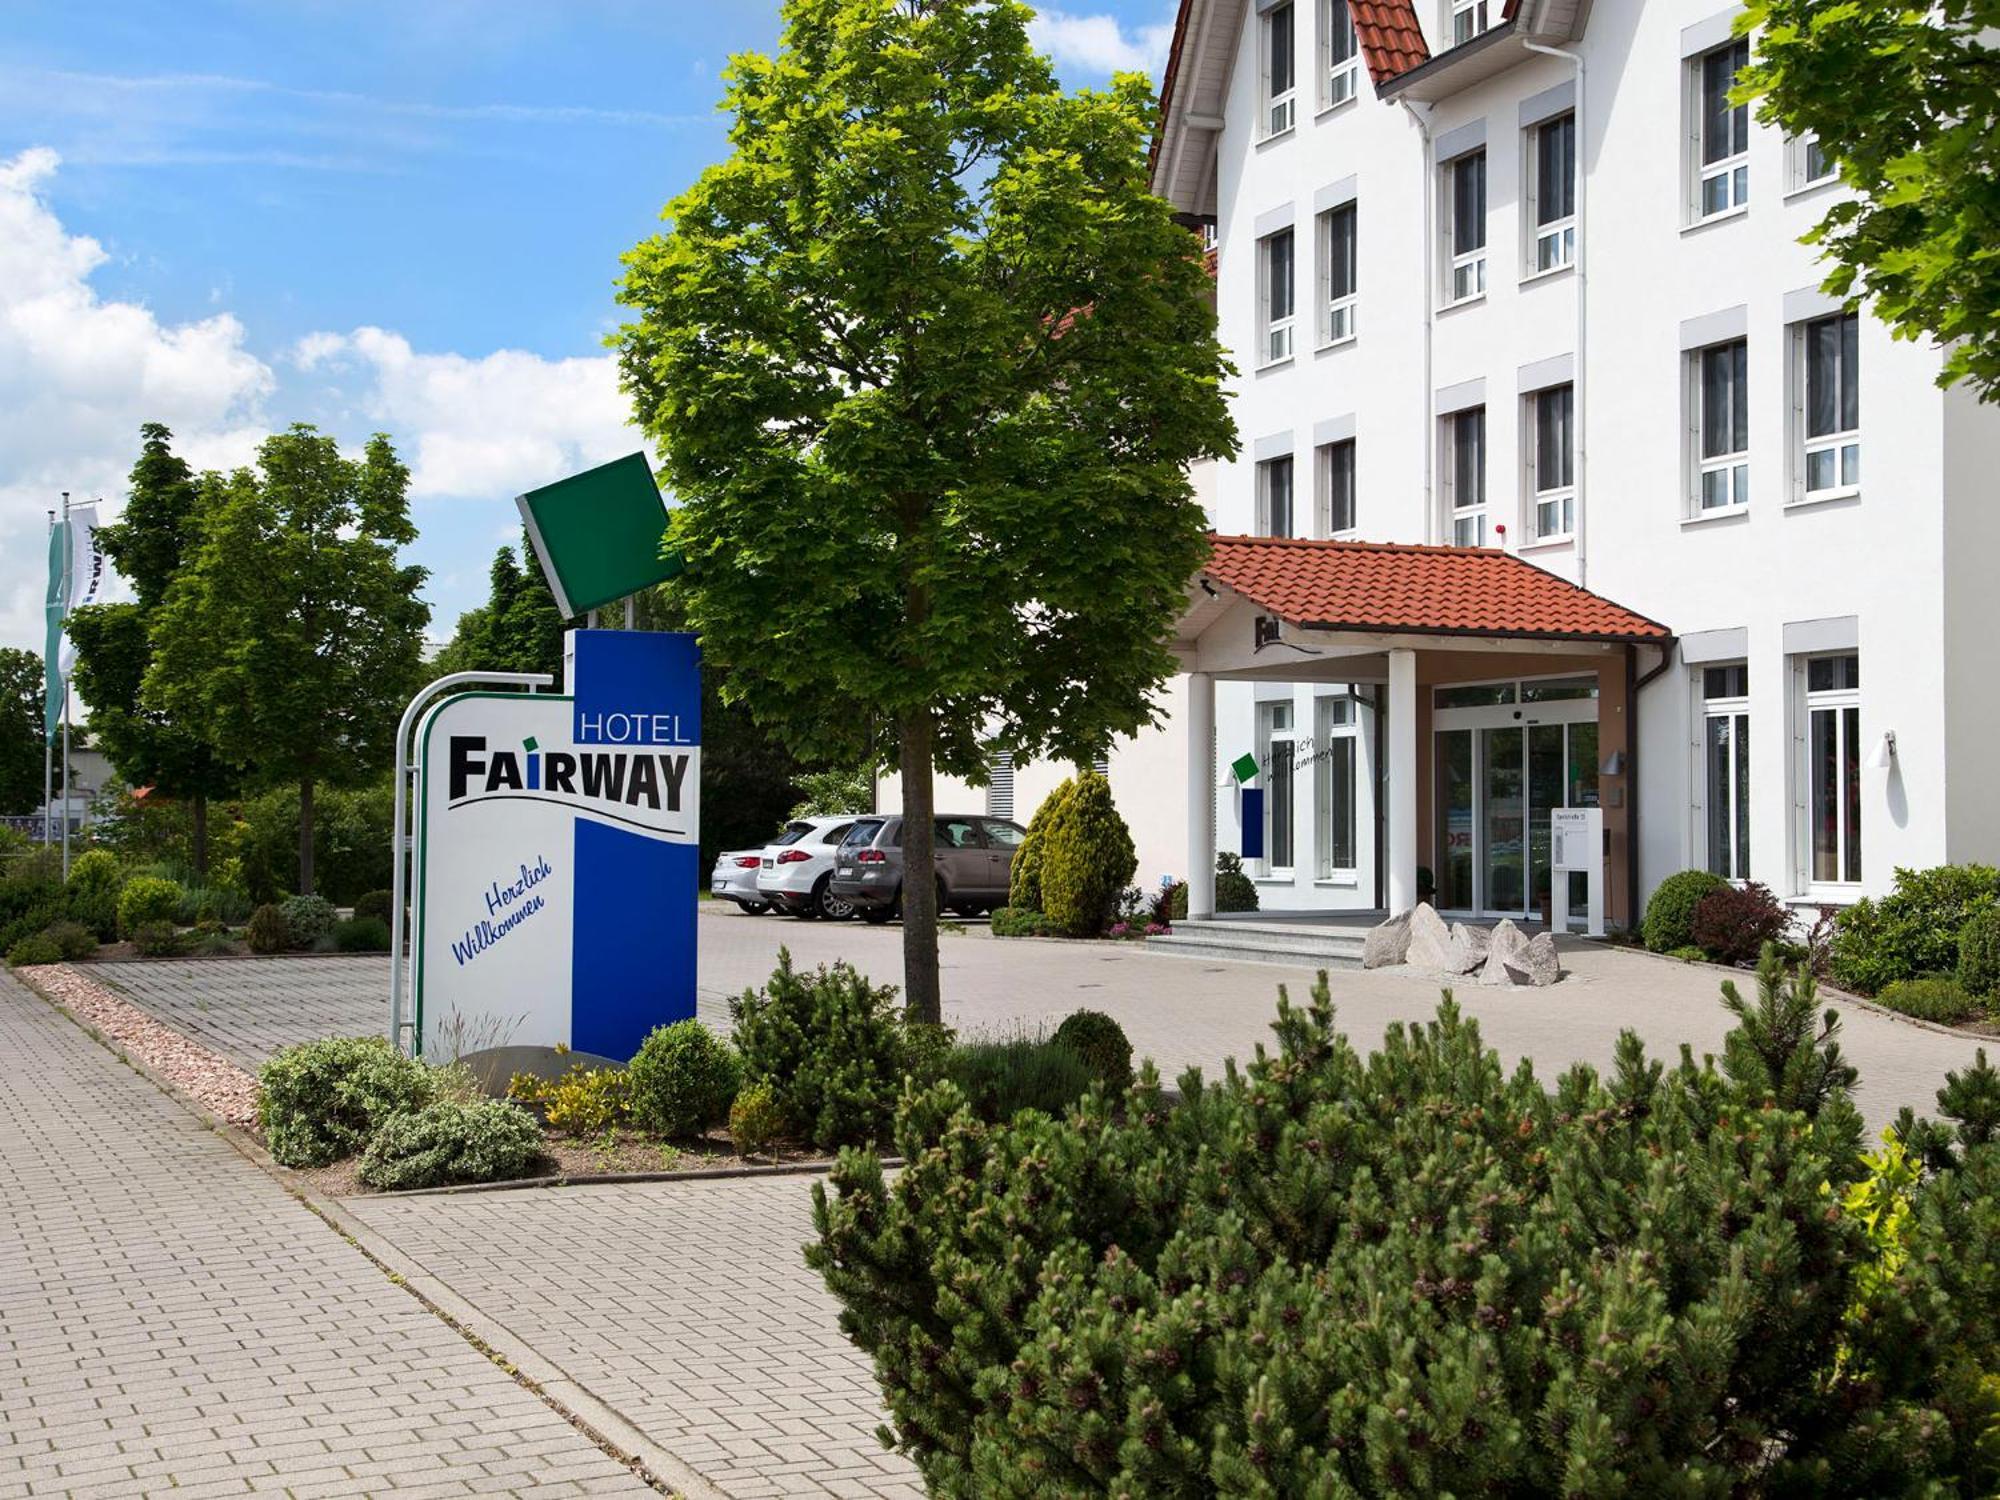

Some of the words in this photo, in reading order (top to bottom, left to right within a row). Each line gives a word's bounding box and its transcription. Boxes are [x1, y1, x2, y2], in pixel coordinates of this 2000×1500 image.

[581, 713, 690, 743] HOTEL
[485, 855, 552, 917] Herzlich
[452, 895, 545, 966] Willkommen
